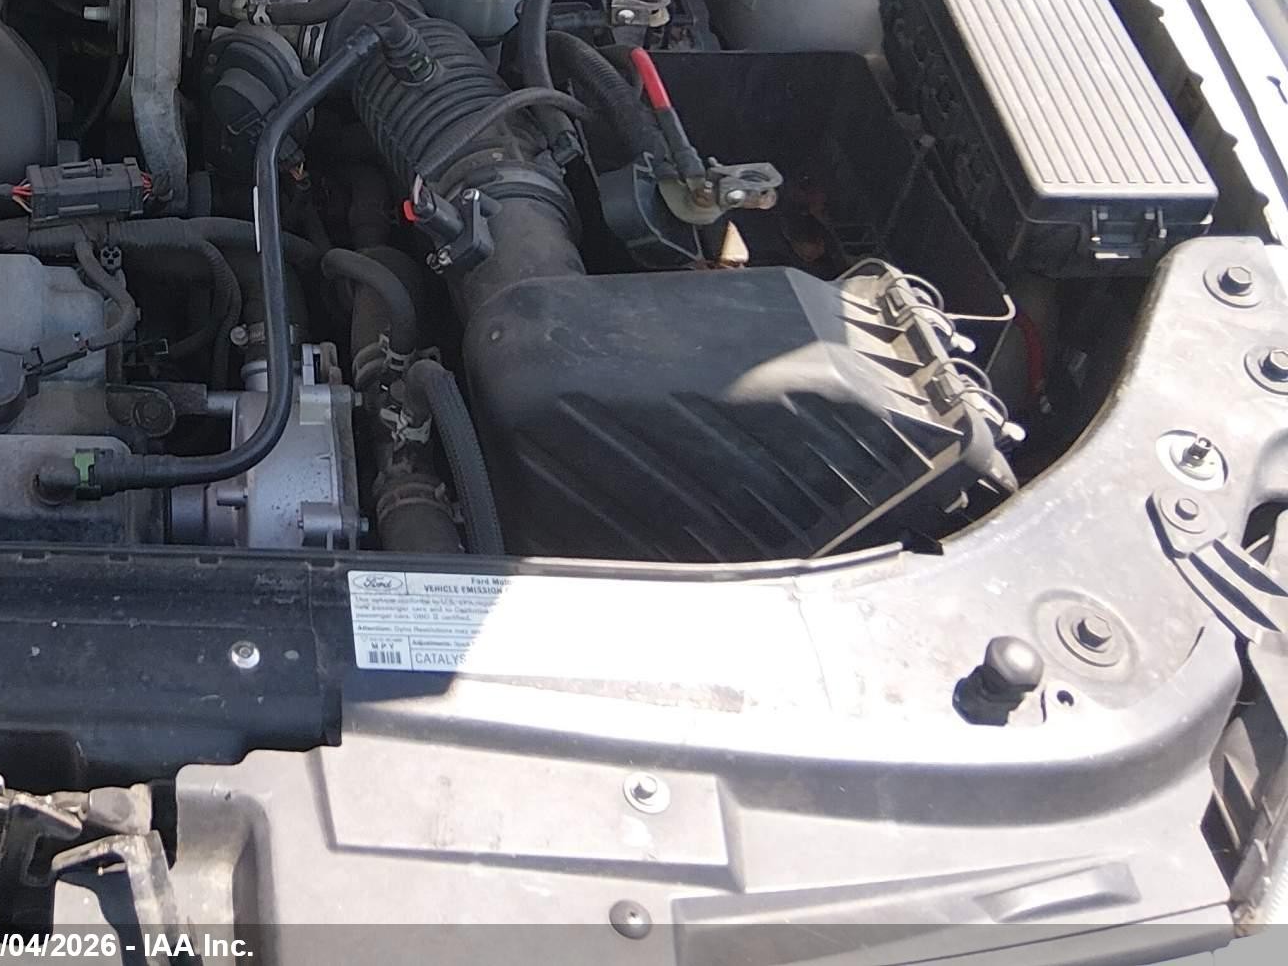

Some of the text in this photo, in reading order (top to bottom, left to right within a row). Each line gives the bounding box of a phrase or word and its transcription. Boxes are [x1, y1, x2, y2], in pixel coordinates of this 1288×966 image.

[362, 576, 392, 589] Ford
[471, 577, 514, 586] Ford Moto
[423, 585, 503, 595] VEHICLE EMISSION
[415, 652, 468, 665] CATALYS
